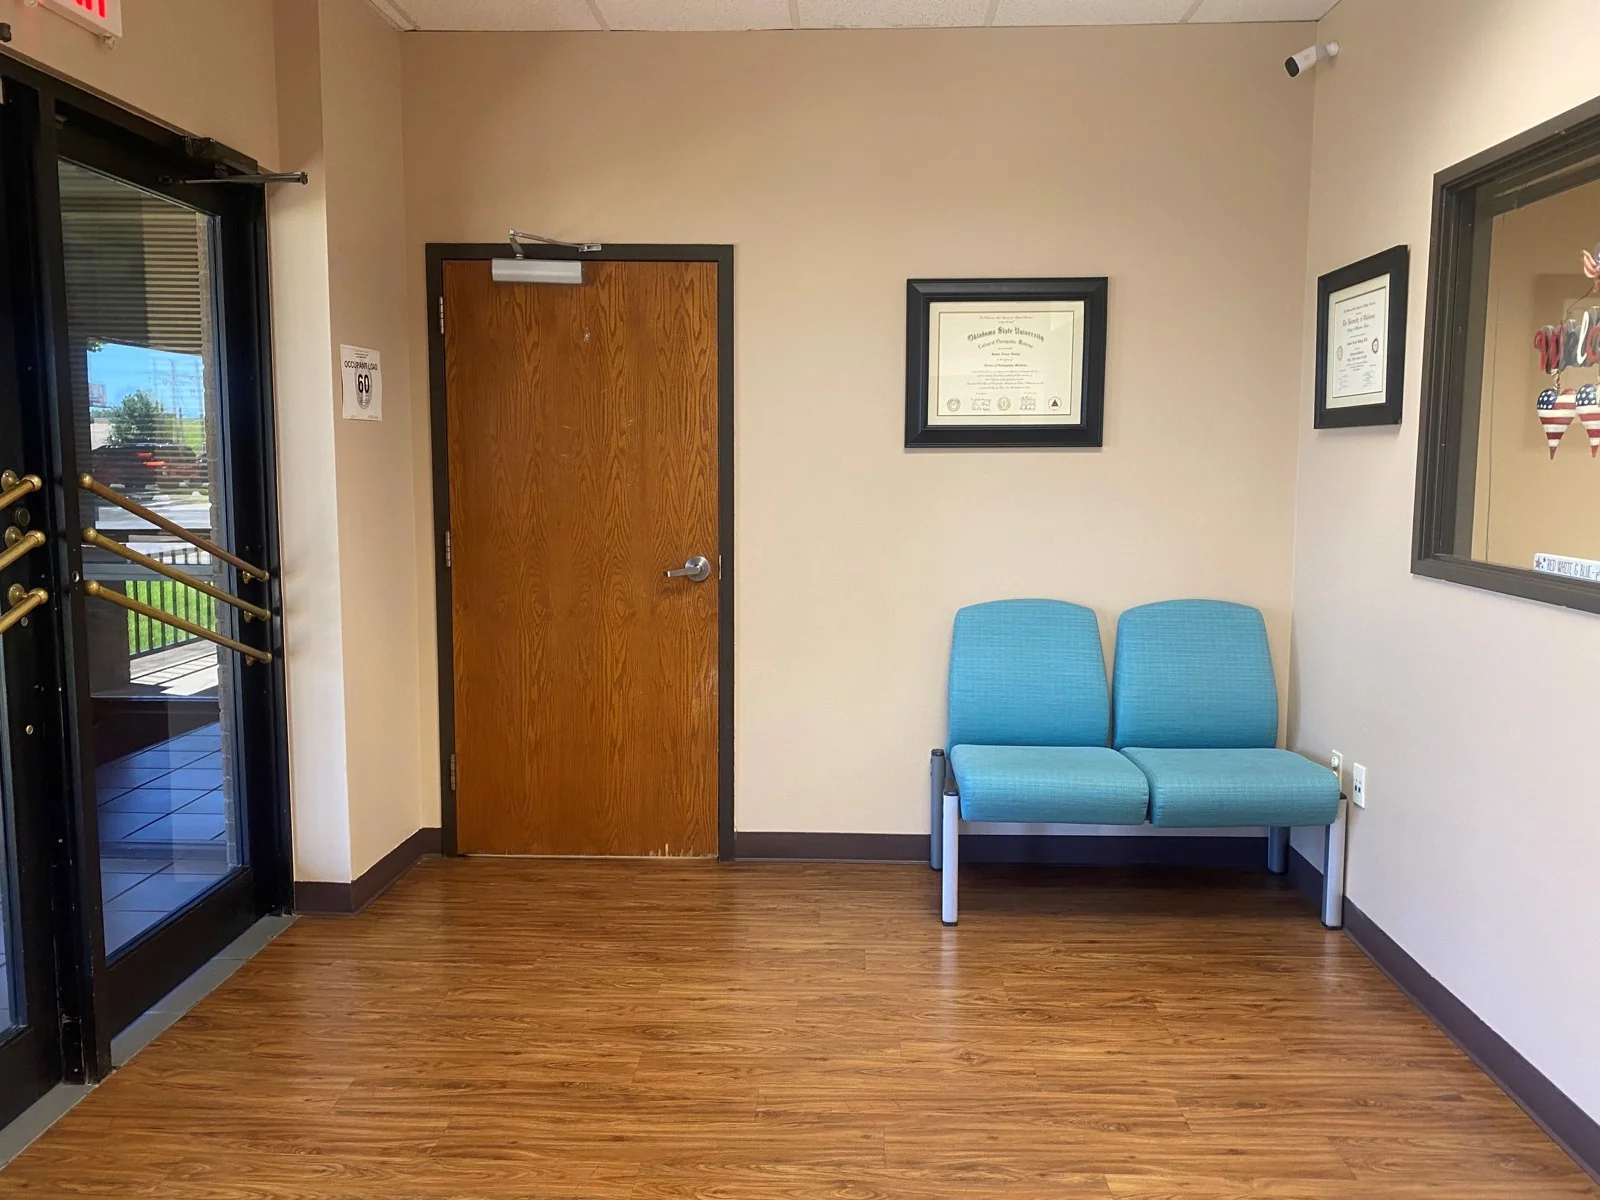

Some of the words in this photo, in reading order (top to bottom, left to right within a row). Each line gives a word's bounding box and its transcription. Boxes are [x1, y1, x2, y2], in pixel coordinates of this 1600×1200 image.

[967, 329, 996, 341] Oklahoma
[998, 326, 1013, 335] State
[1015, 326, 1044, 342] University
[344, 360, 368, 370] OCCUPANT
[368, 362, 379, 371] LOAD
[357, 373, 370, 394] 60
